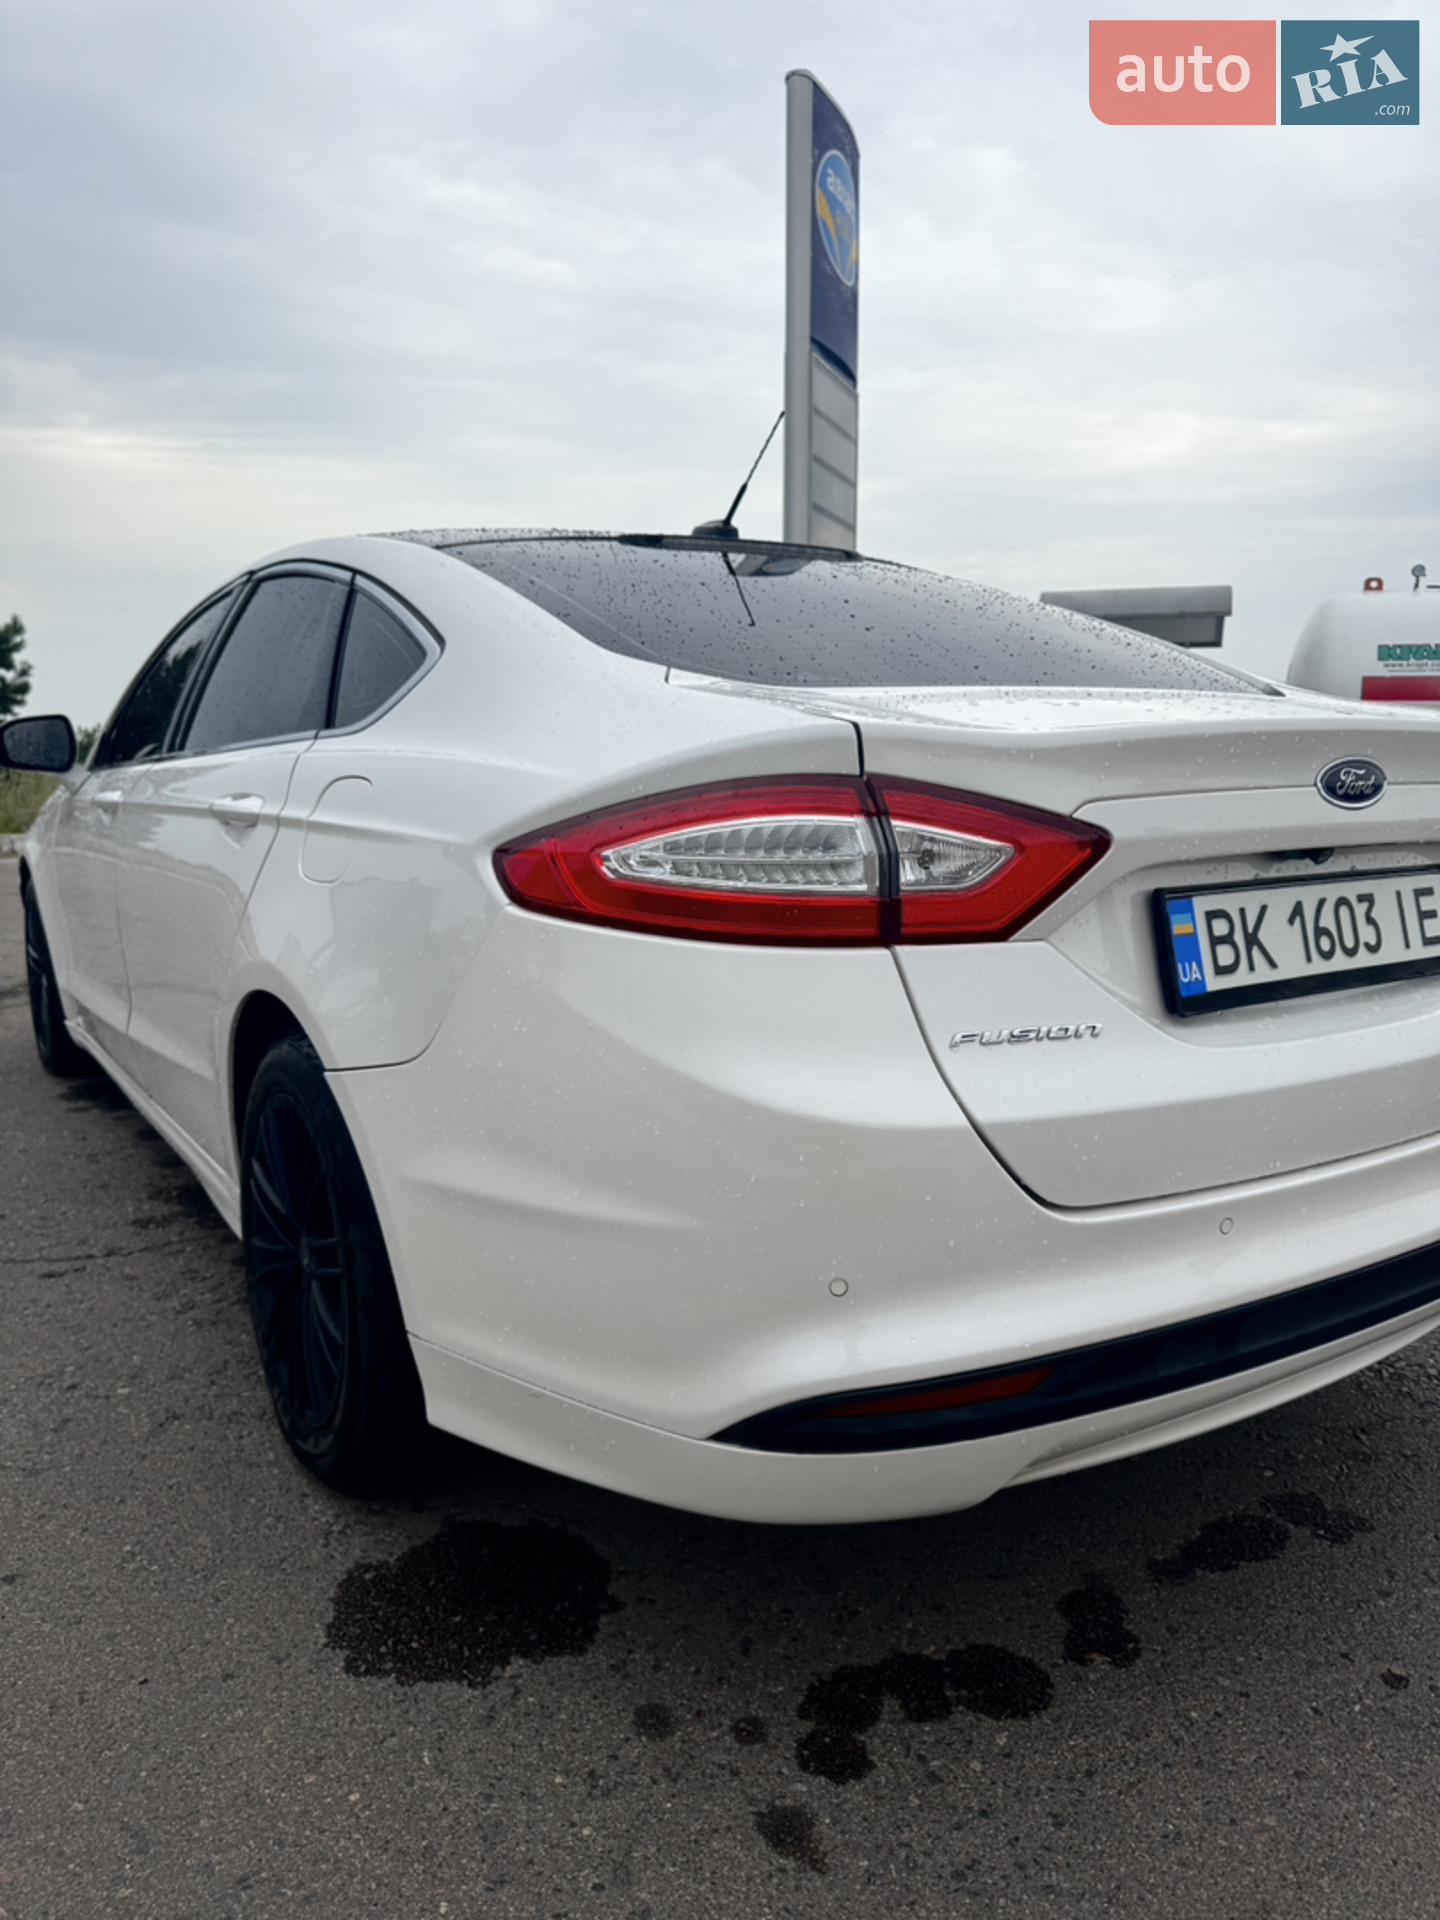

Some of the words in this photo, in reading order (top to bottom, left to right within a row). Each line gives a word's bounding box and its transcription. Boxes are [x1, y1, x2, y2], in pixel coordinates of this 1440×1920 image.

[1336, 767, 1375, 796] Ford
[1204, 903, 1279, 977] BK
[1287, 892, 1383, 964] 1603
[1178, 961, 1203, 983] UA
